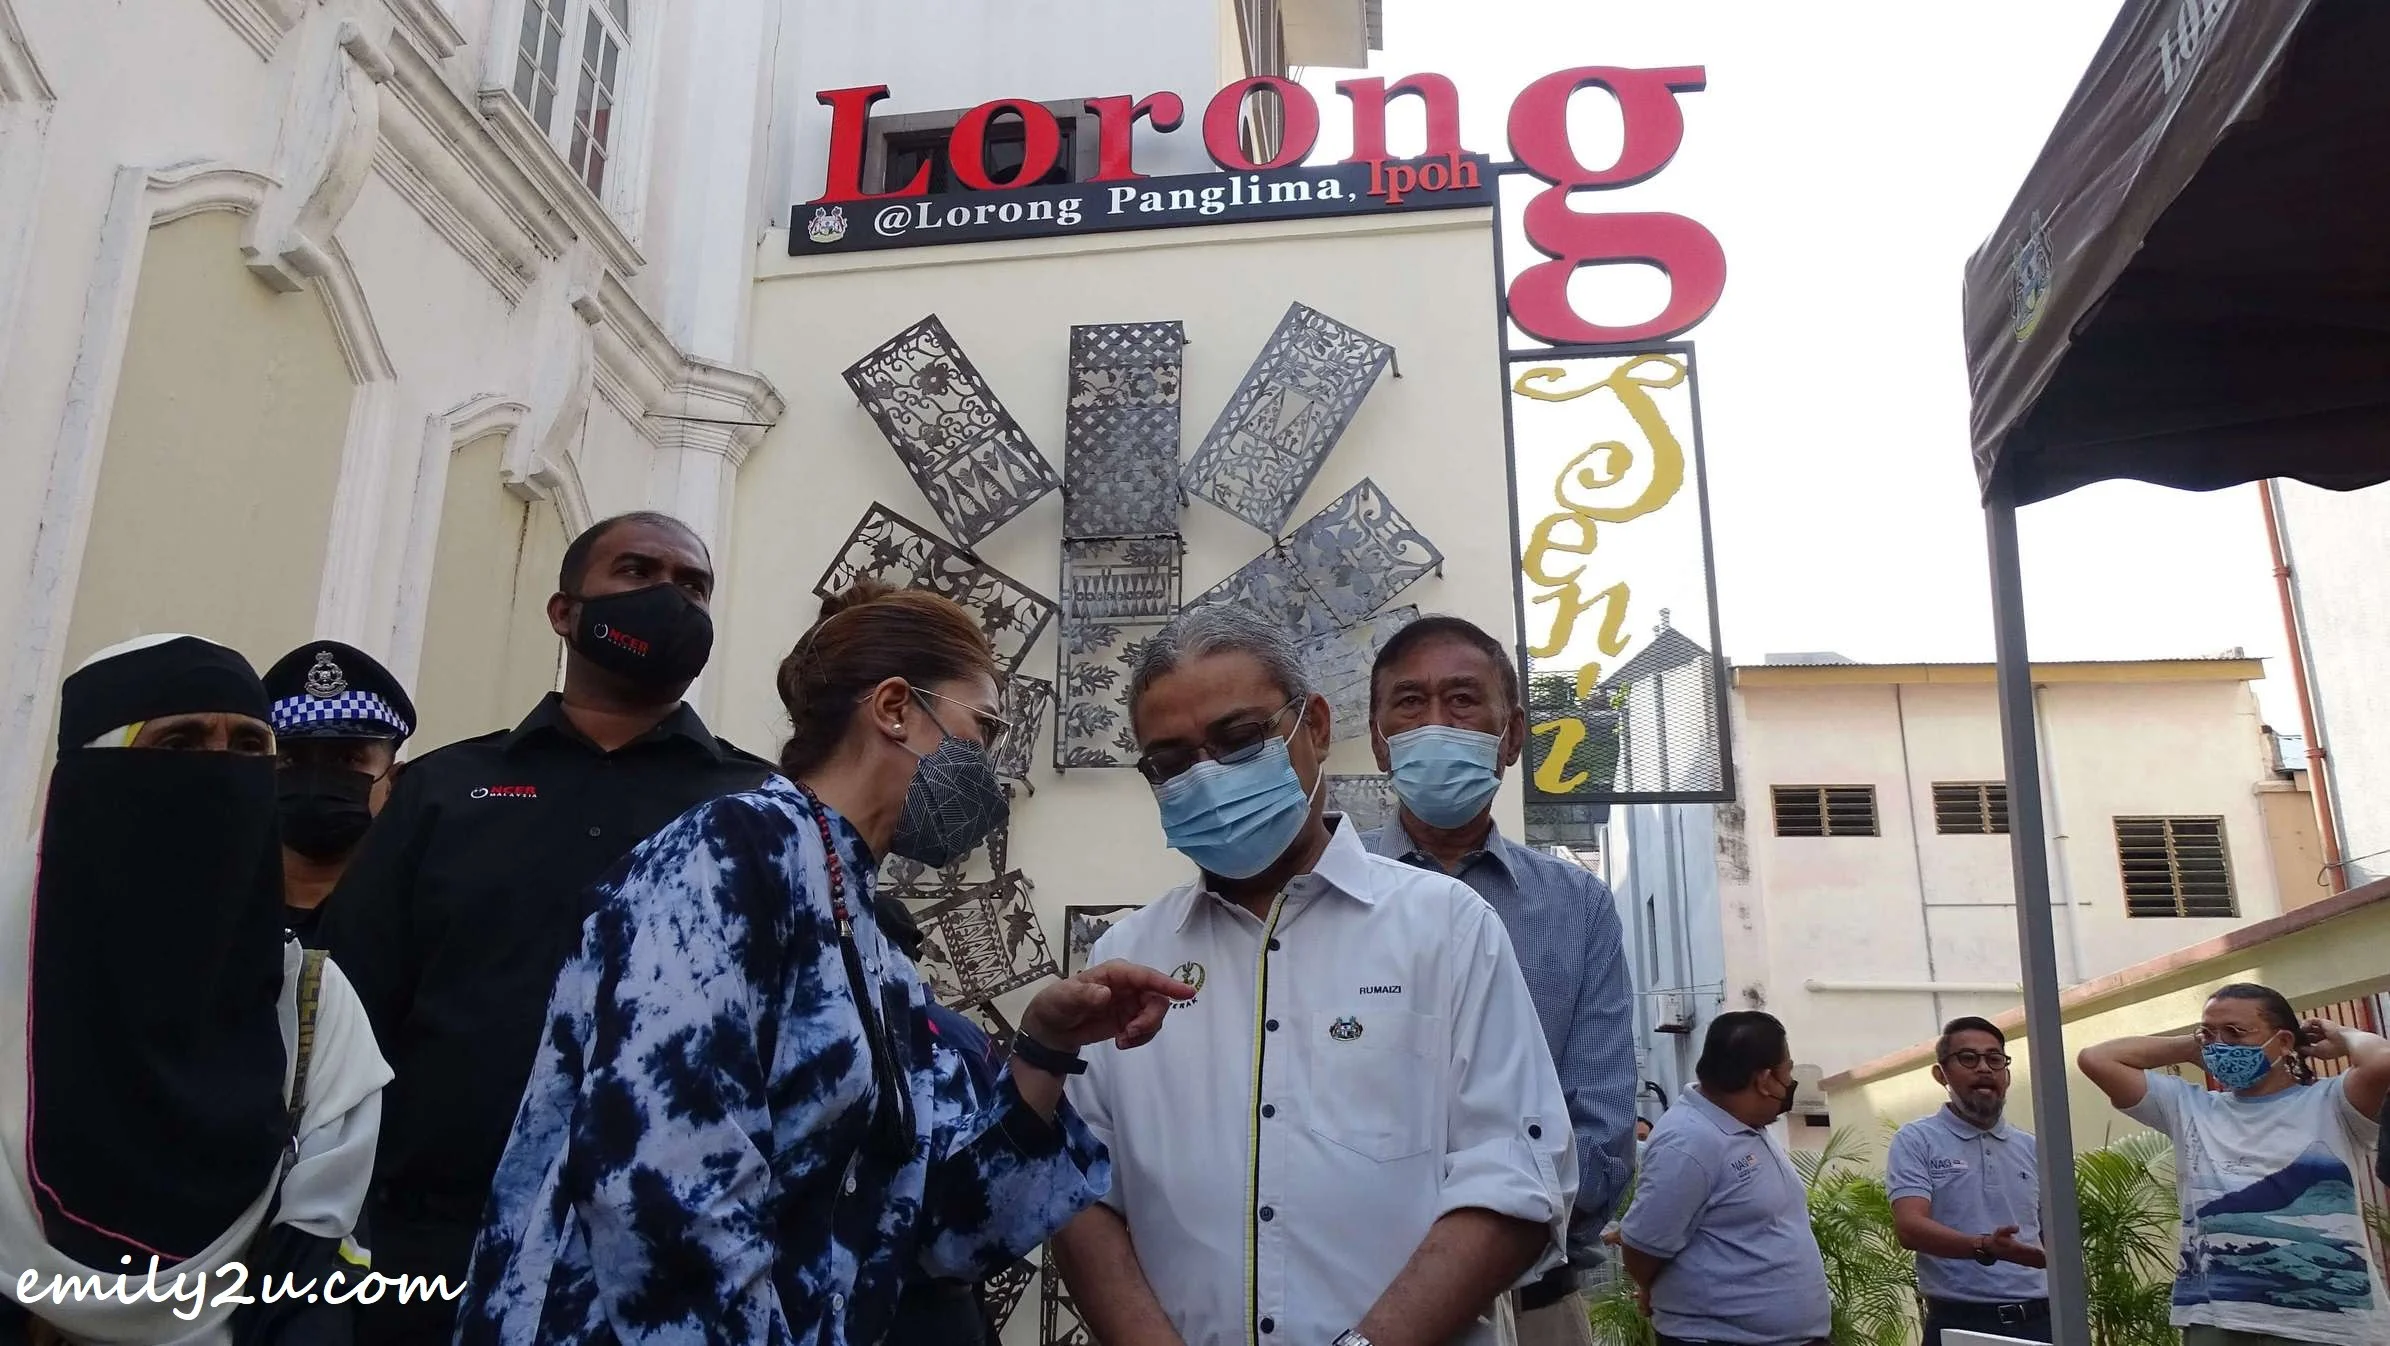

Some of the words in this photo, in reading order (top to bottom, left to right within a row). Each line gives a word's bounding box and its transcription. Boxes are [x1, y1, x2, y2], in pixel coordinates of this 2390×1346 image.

[873, 196, 1083, 237] @Lorong
[1107, 174, 1357, 215] Panglima,
[1366, 157, 1483, 204] Ipoh
[815, 64, 1727, 344] Lorong
[490, 785, 537, 794] NCER
[1359, 985, 1402, 995] RUMAIZI
[1169, 997, 1198, 1009] ERAK
